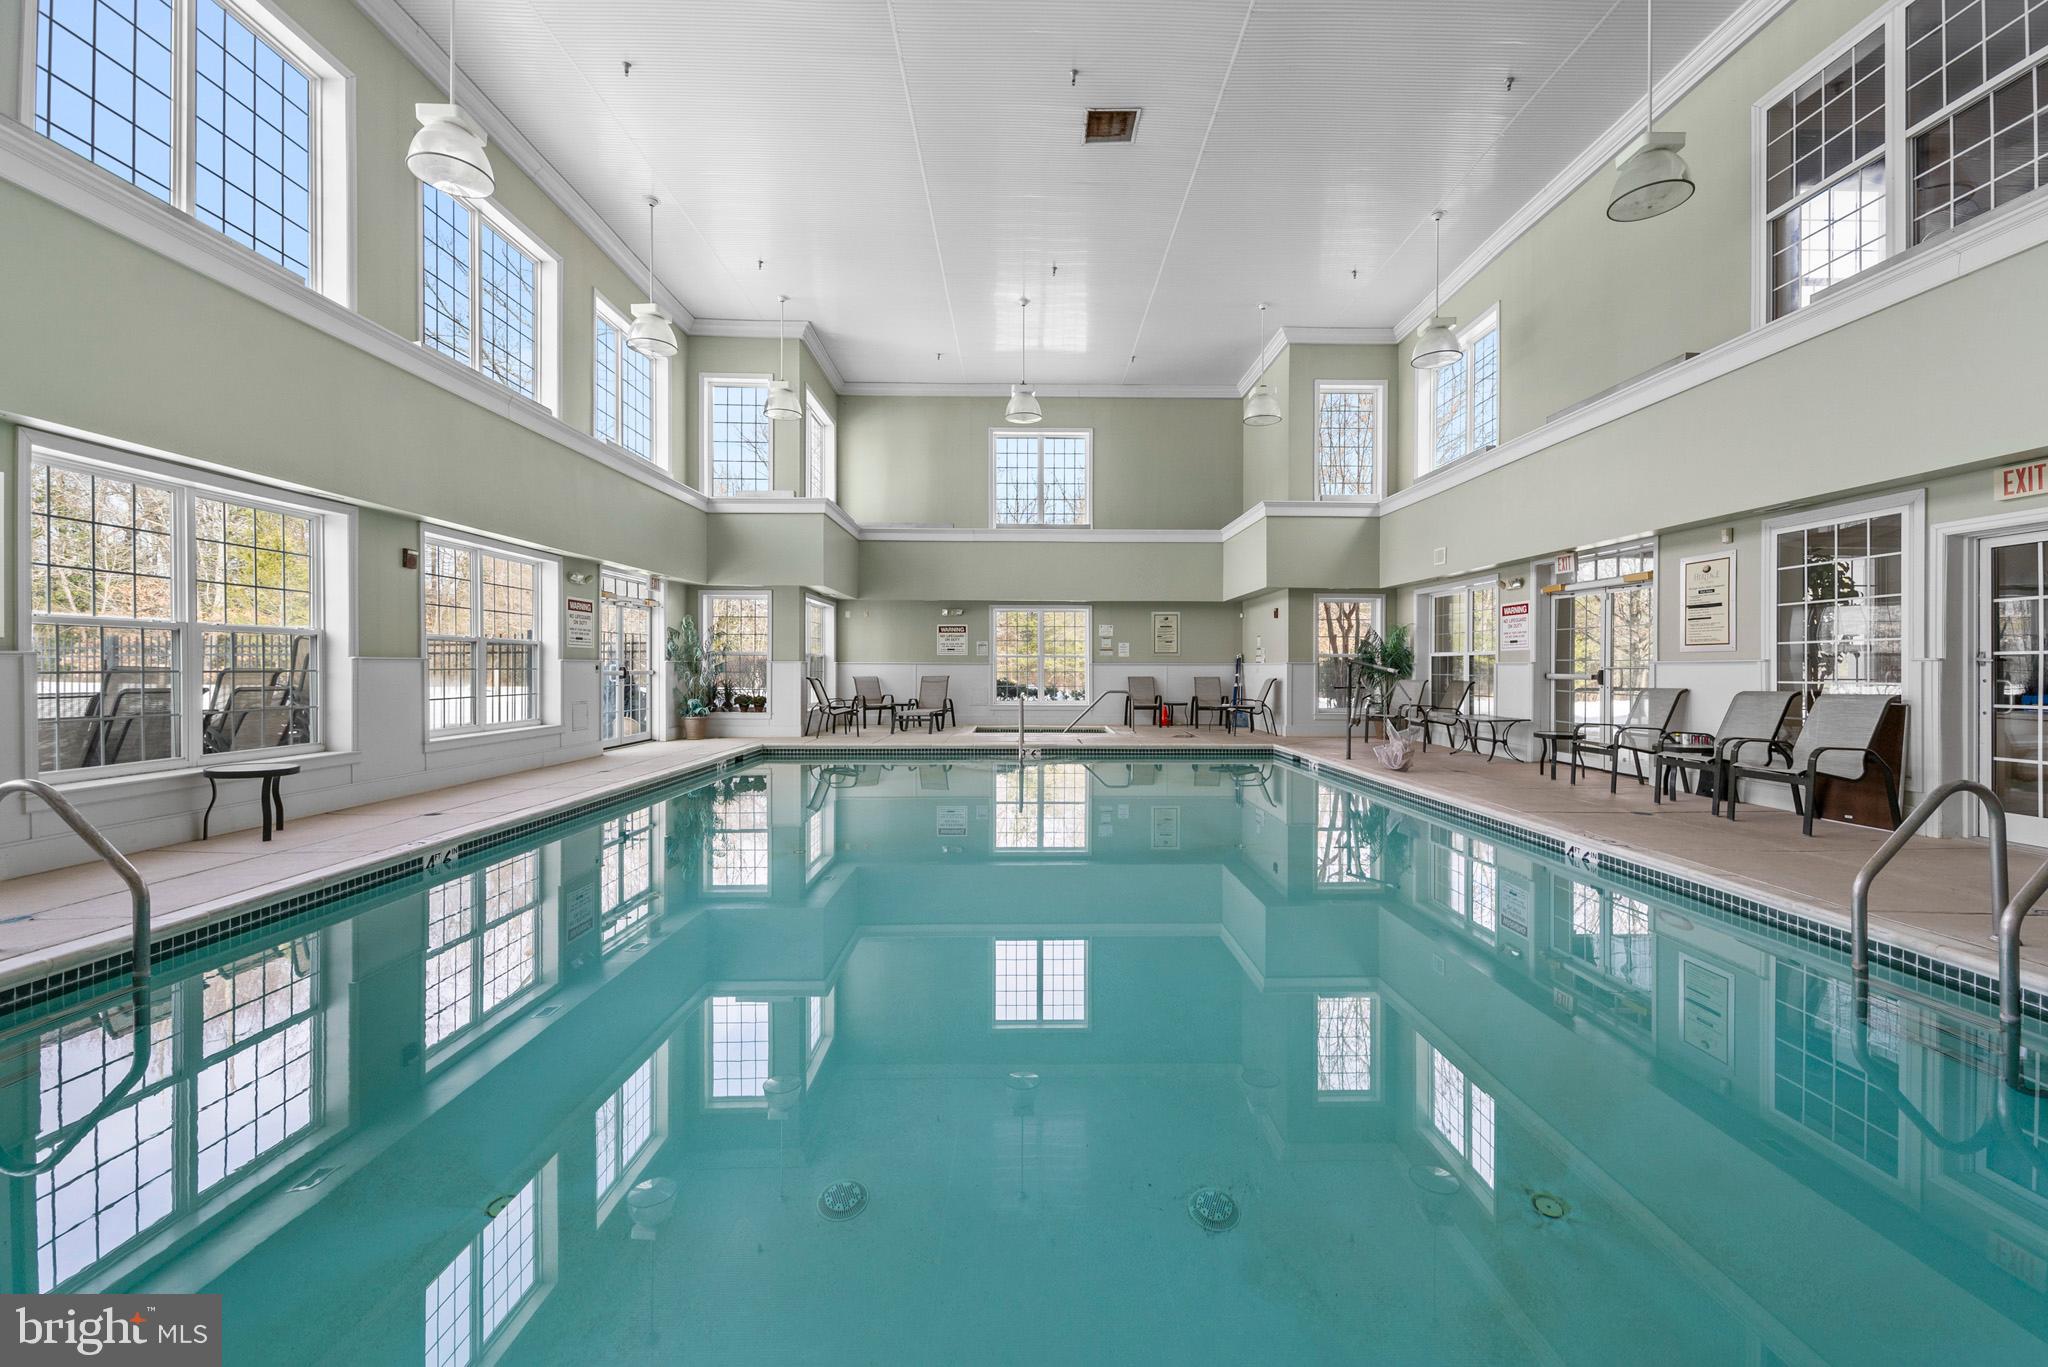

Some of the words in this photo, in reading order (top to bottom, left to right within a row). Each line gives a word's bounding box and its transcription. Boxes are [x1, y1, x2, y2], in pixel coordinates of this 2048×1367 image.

[2003, 463, 2047, 496] EXIT
[1558, 556, 1571, 571] EXIT
[570, 601, 592, 612] WARNING
[1503, 604, 1528, 615] WARNING
